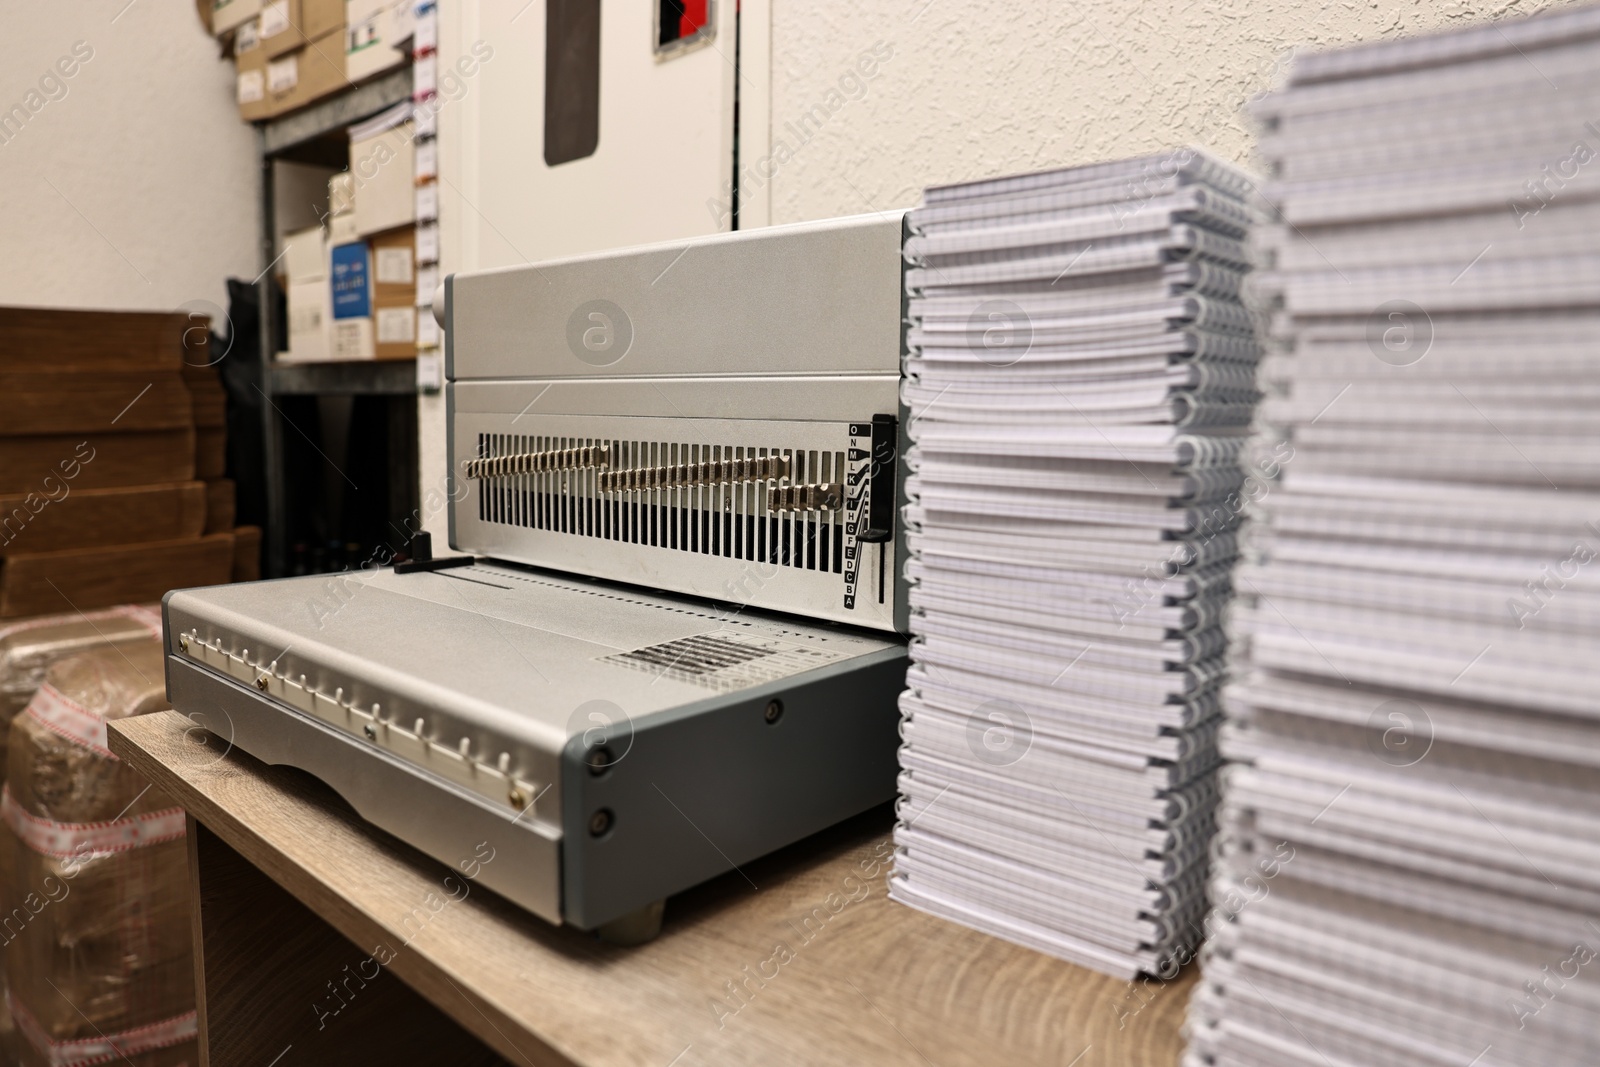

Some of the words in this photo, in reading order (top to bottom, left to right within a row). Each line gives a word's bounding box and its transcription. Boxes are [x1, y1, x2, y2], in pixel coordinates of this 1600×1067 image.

[850, 426, 858, 434] O
[851, 439, 857, 447] N
[849, 451, 857, 459] M
[850, 463, 855, 471] L
[848, 475, 856, 484] K
[849, 487, 855, 495] J
[848, 512, 854, 521] H
[847, 524, 854, 533] G
[848, 537, 853, 545] F
[847, 549, 853, 557] E
[846, 573, 853, 581] C
[847, 585, 852, 594] B
[846, 597, 853, 605] A
